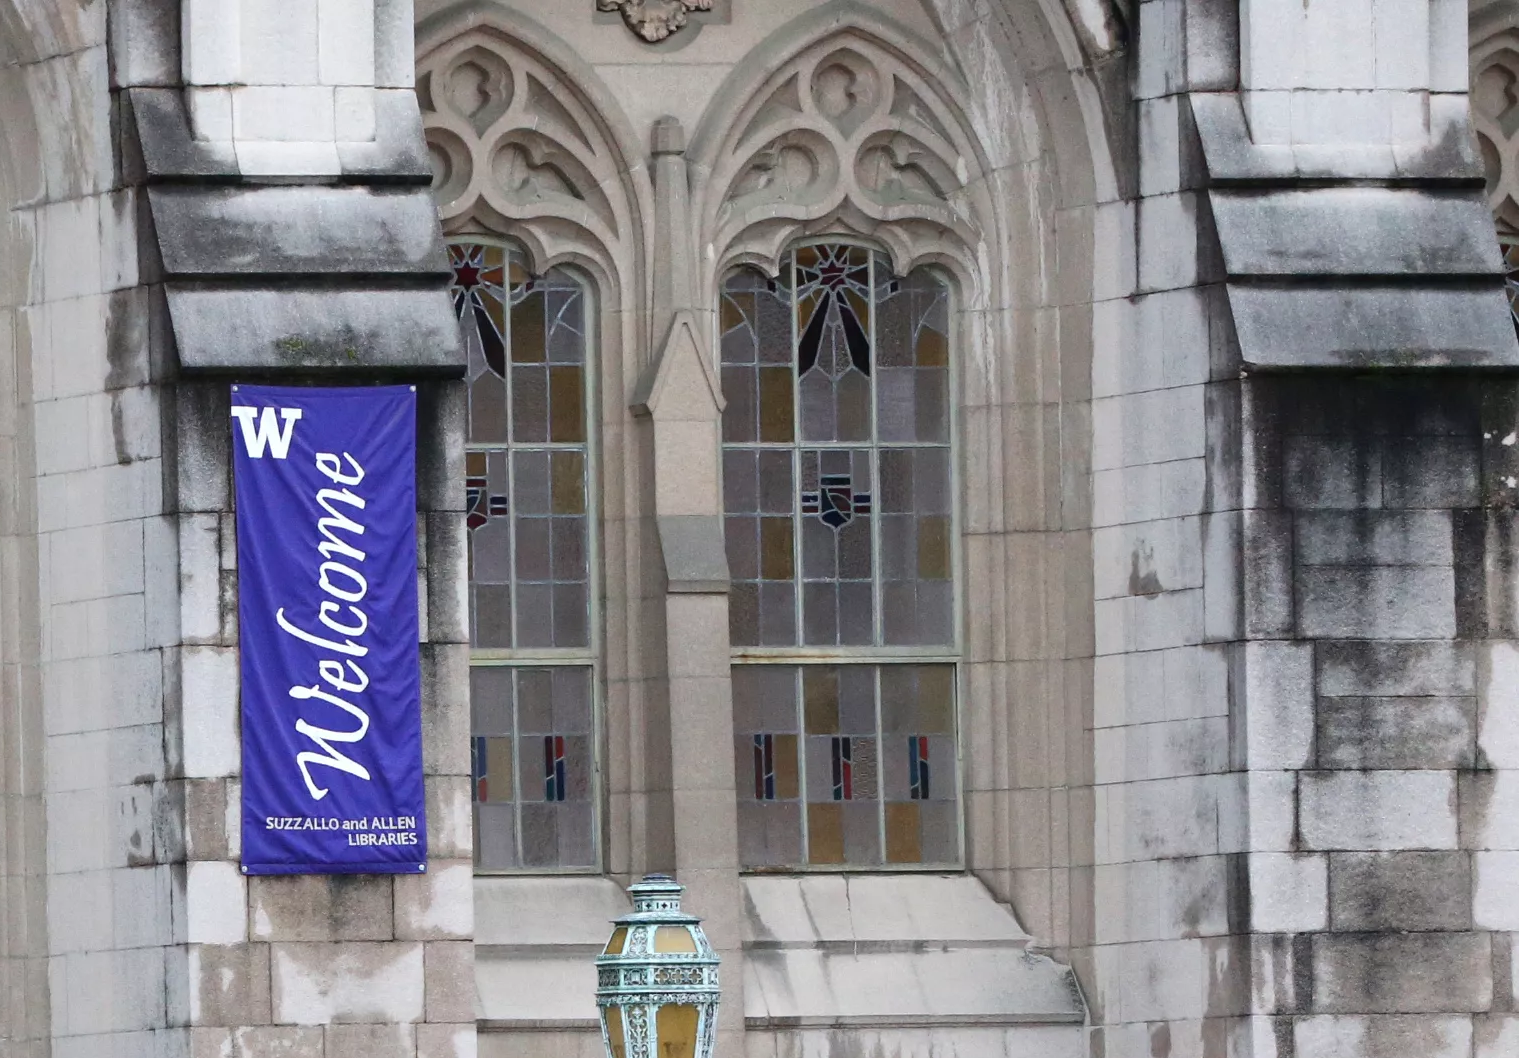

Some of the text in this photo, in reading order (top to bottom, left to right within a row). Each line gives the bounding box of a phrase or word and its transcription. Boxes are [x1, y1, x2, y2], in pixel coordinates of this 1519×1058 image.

[231, 406, 303, 459] W
[275, 450, 371, 801] Welcome
[265, 815, 416, 832] SUZZALLO and ALLEN
[348, 832, 418, 847] LIBRARIES
